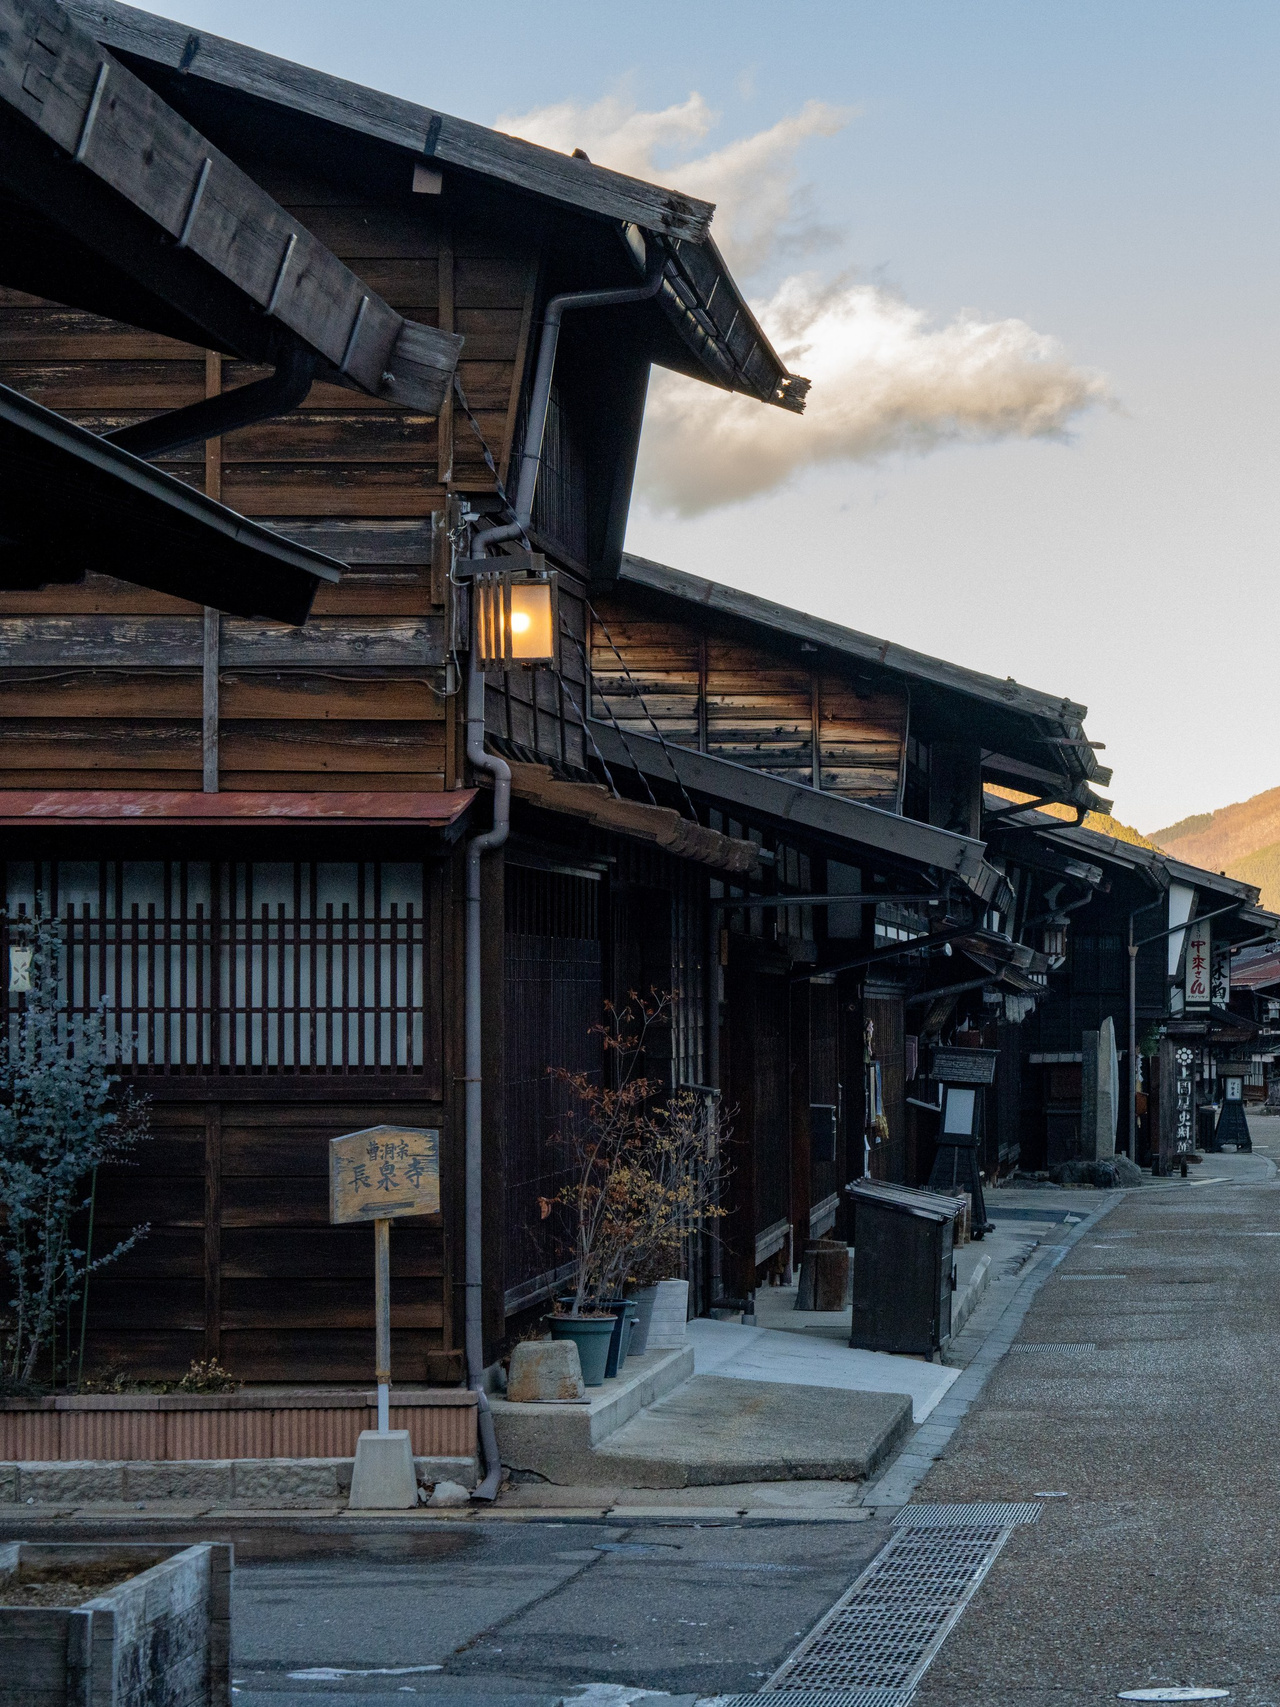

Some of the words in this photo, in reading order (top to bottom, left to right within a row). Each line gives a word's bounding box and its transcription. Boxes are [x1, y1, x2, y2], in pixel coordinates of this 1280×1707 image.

[366, 1139, 409, 1161] 曹洞宗
[348, 1157, 425, 1193] 長泉寺
